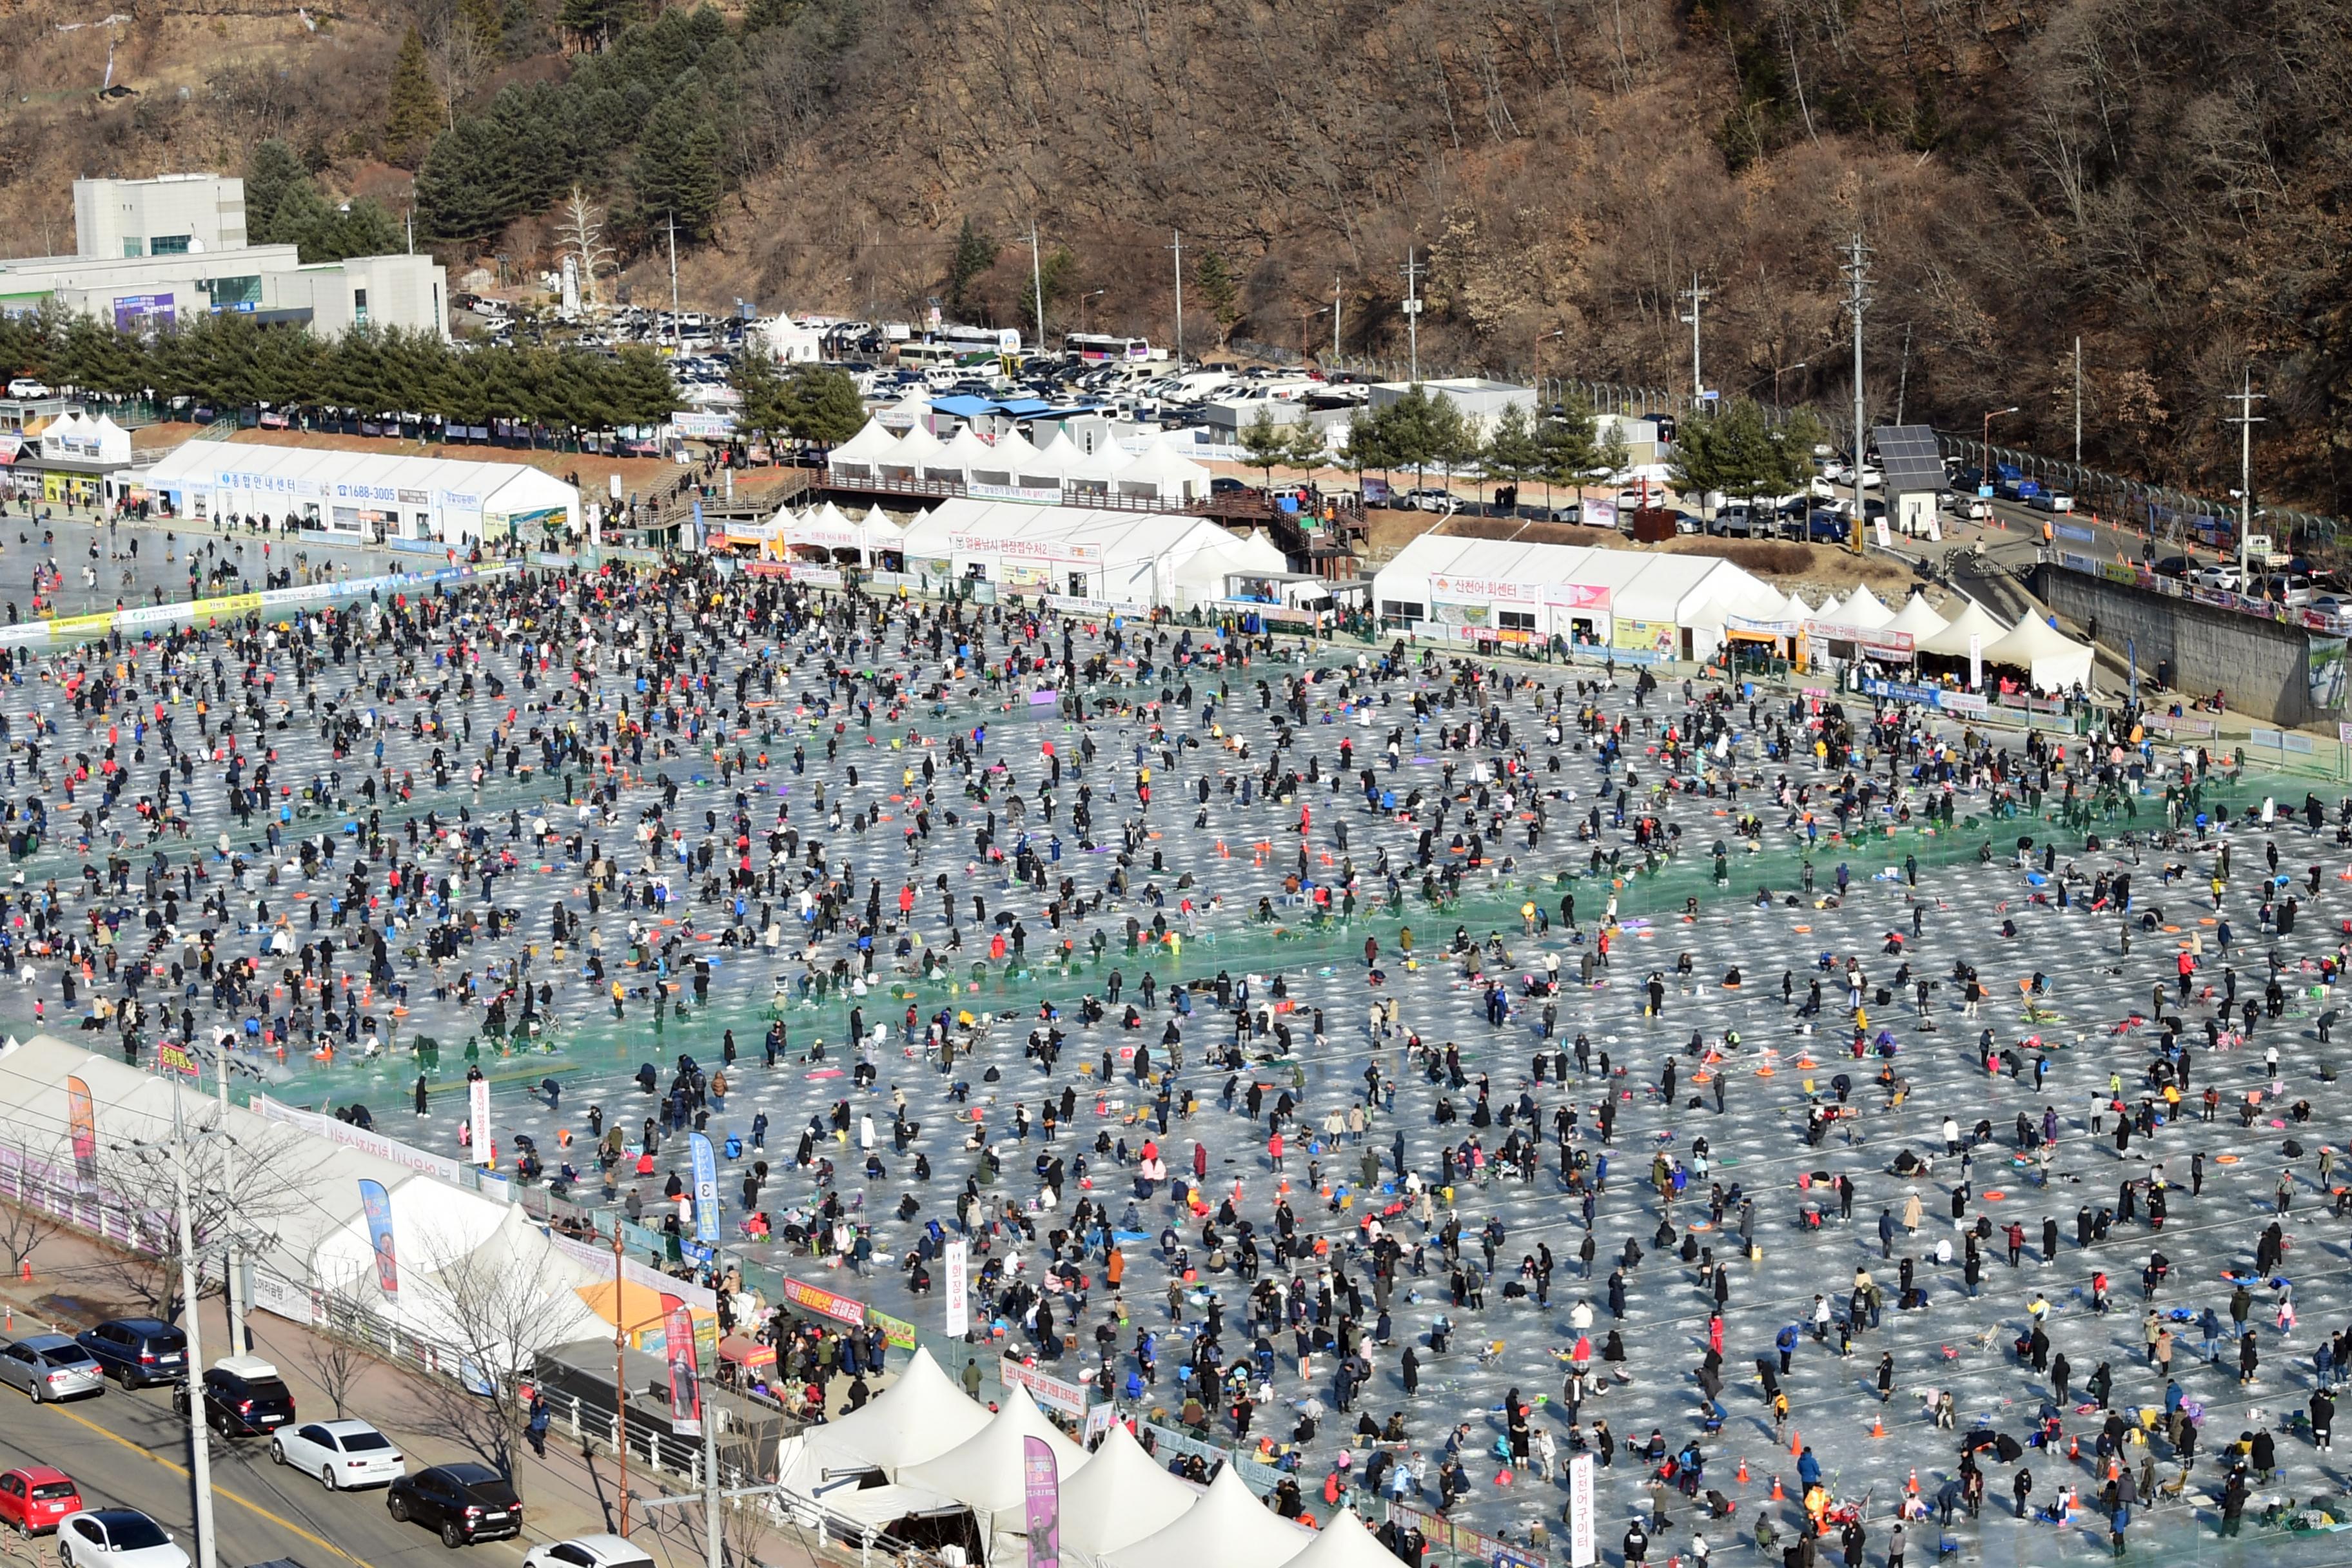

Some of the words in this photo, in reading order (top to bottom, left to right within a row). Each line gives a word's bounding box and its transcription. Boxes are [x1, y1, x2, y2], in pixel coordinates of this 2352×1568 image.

[232, 474, 296, 493] 종합안내센터
[349, 485, 395, 501] 1688-3005
[965, 537, 998, 551] 얼음낚시
[1001, 538, 1048, 554] 현장접수처2
[1455, 580, 1484, 594] 산천어
[1487, 582, 1517, 598] 회센터
[1818, 623, 1837, 636] 산천어
[1838, 625, 1856, 638] 구이터
[952, 1264, 961, 1309] 화장실
[1577, 1464, 1589, 1548] 산천어구이터
